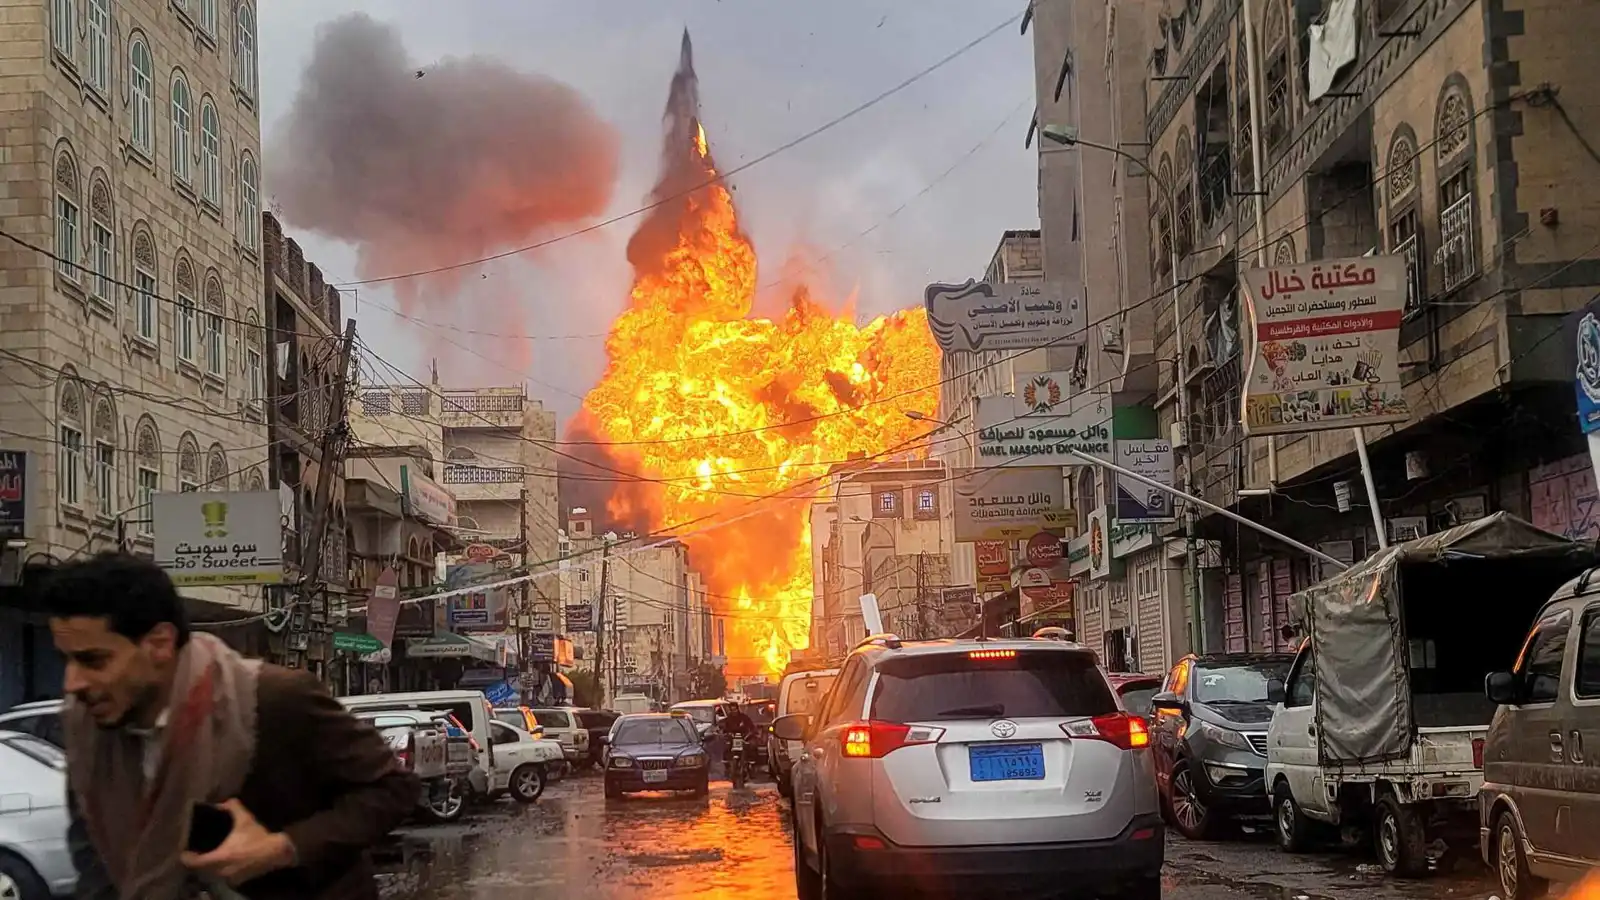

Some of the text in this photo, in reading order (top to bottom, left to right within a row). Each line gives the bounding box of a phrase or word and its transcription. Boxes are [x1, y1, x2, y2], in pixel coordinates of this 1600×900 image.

[1261, 263, 1376, 300] مكتبة خيال
[1024, 298, 1062, 315] وهيب
[1266, 295, 1377, 317] للعطور ومستحضرات التجميل
[1311, 321, 1342, 334] المكتبية
[1332, 337, 1361, 350] تحف
[1311, 354, 1343, 367] هدايا
[1292, 369, 1321, 385] العاب
[978, 425, 1108, 443] وائل مسعود للصرافة
[979, 442, 1110, 456] WAEL MASOUD EXCHANGE
[1133, 453, 1160, 467] الخير
[969, 492, 1051, 508] وائل مسعود
[971, 509, 1014, 519] والتحويلات
[174, 543, 257, 559] سو سويت
[174, 555, 259, 569] So Sweet
